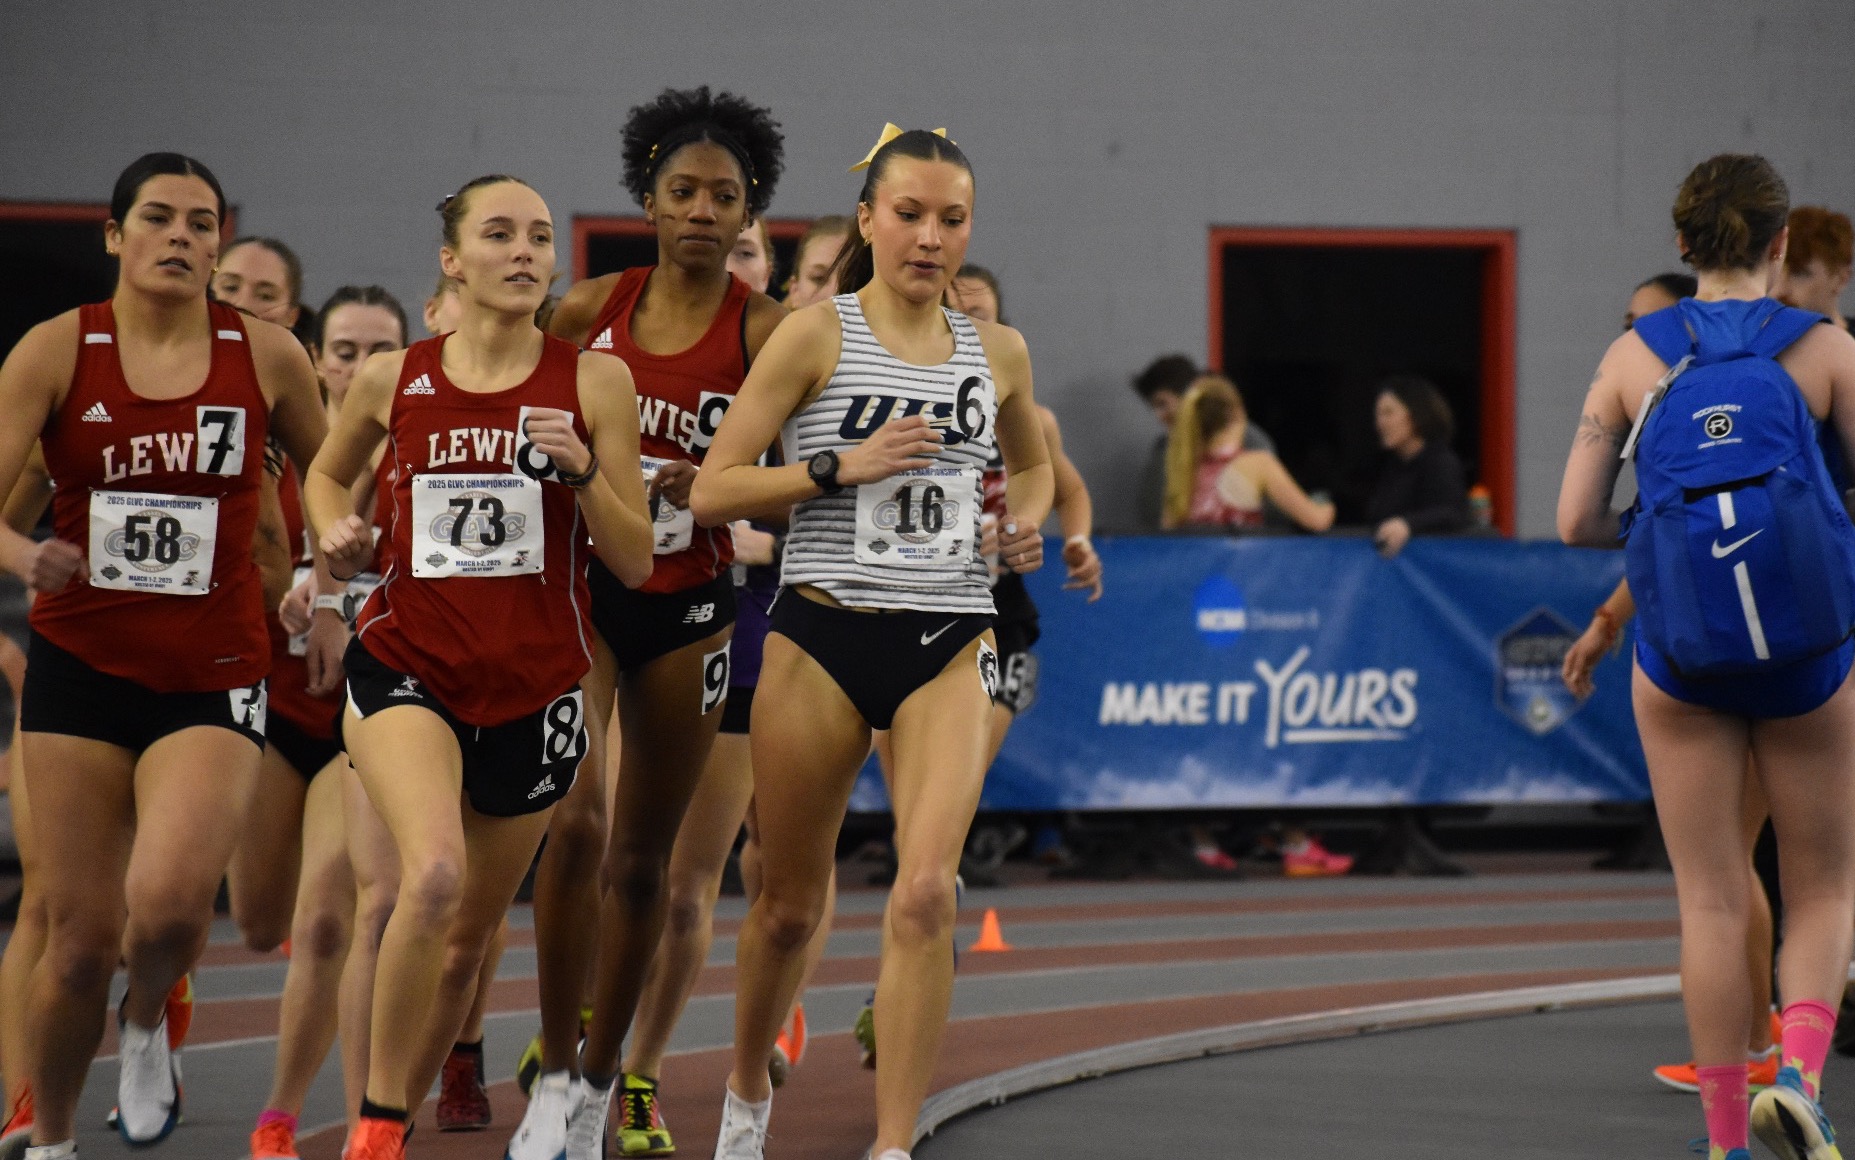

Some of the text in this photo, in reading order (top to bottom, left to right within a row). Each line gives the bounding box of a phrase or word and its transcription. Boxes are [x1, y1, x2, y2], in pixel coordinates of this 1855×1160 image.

[403, 385, 436, 396] adidas
[956, 375, 986, 439] 6
[81, 414, 113, 423] adidas
[200, 410, 239, 473] 7
[637, 395, 697, 453] WIS
[102, 432, 195, 484] LEW
[427, 427, 515, 469] LEWI
[107, 495, 203, 510] 2025 GLVC CHAMPIONSHIPS
[427, 479, 525, 489] 2025 GLVC CHAMPIONSHIPS
[449, 497, 506, 547] 73
[895, 486, 945, 534] 16
[124, 515, 182, 565] 58
[705, 652, 728, 713] 9
[1100, 645, 1419, 748] MAKE IT YOURS
[546, 696, 578, 762] 8
[527, 783, 556, 800] adidas
